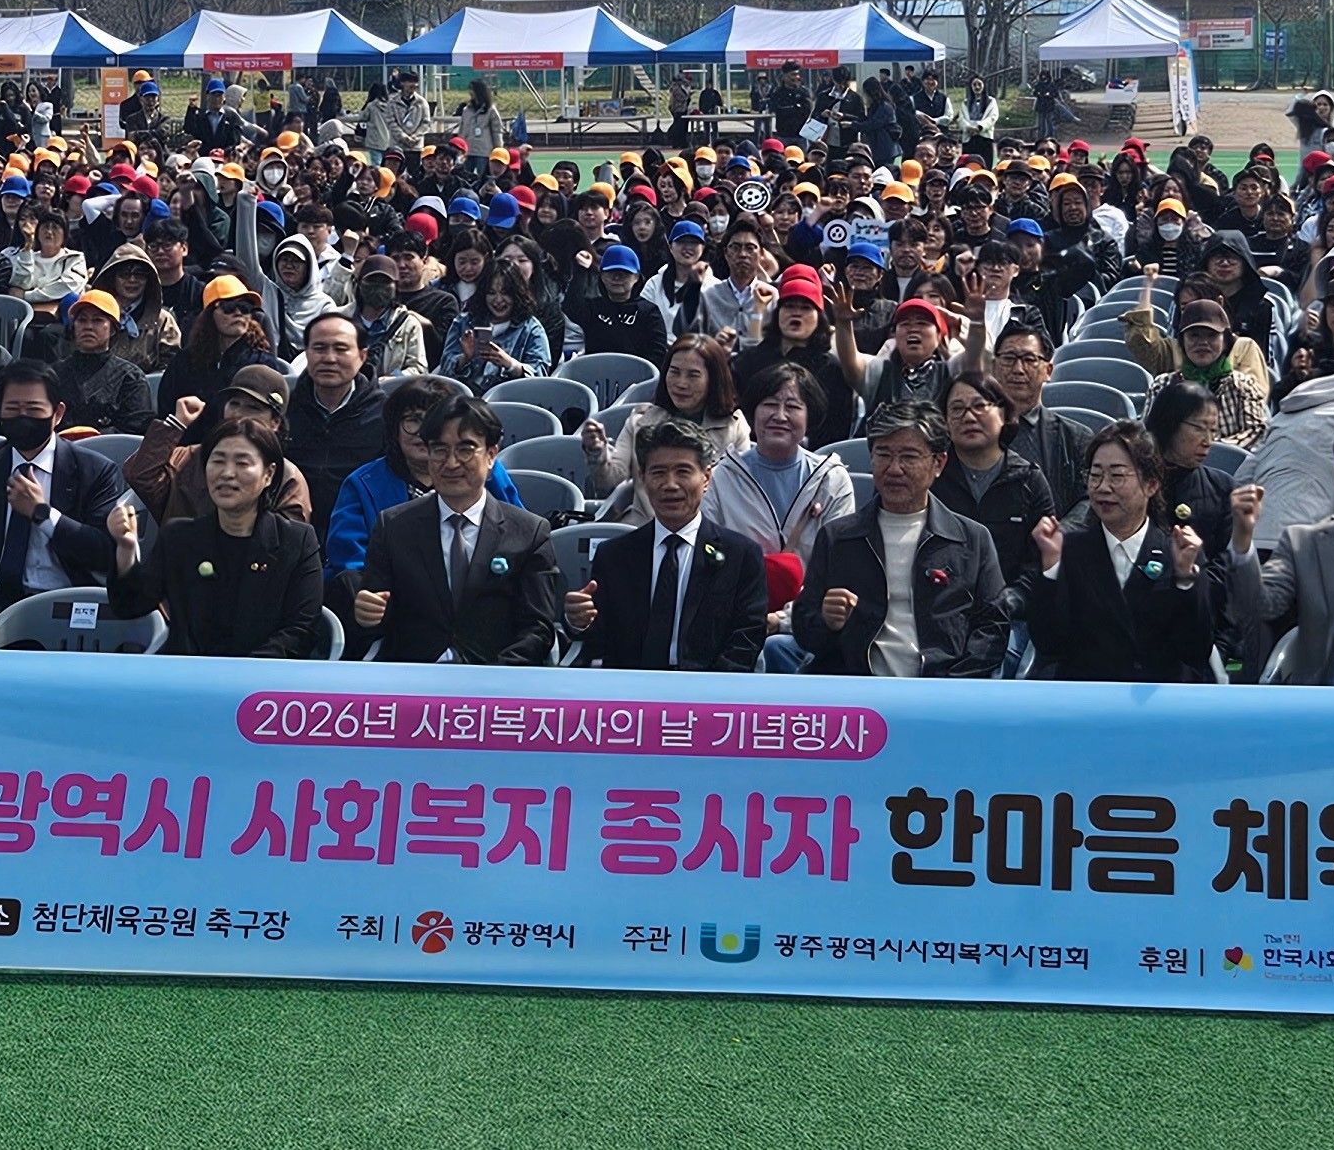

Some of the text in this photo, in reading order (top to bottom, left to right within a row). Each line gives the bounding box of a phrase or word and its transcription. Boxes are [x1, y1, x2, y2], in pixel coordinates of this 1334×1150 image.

[252, 699, 872, 754] 2026년 사회복지사의 날 기념행사
[230, 777, 574, 873] 사회복지
[599, 788, 862, 884] 종사자
[884, 785, 1182, 898] 한마음
[32, 902, 199, 938] 첨단체육공원
[204, 906, 292, 943] 축구장
[336, 914, 386, 944] 주최
[463, 920, 577, 950] 광주광역시
[622, 924, 674, 954] 주관
[773, 932, 1091, 973] 광주광역시사회복지사협회
[1138, 945, 1190, 975] 후원
